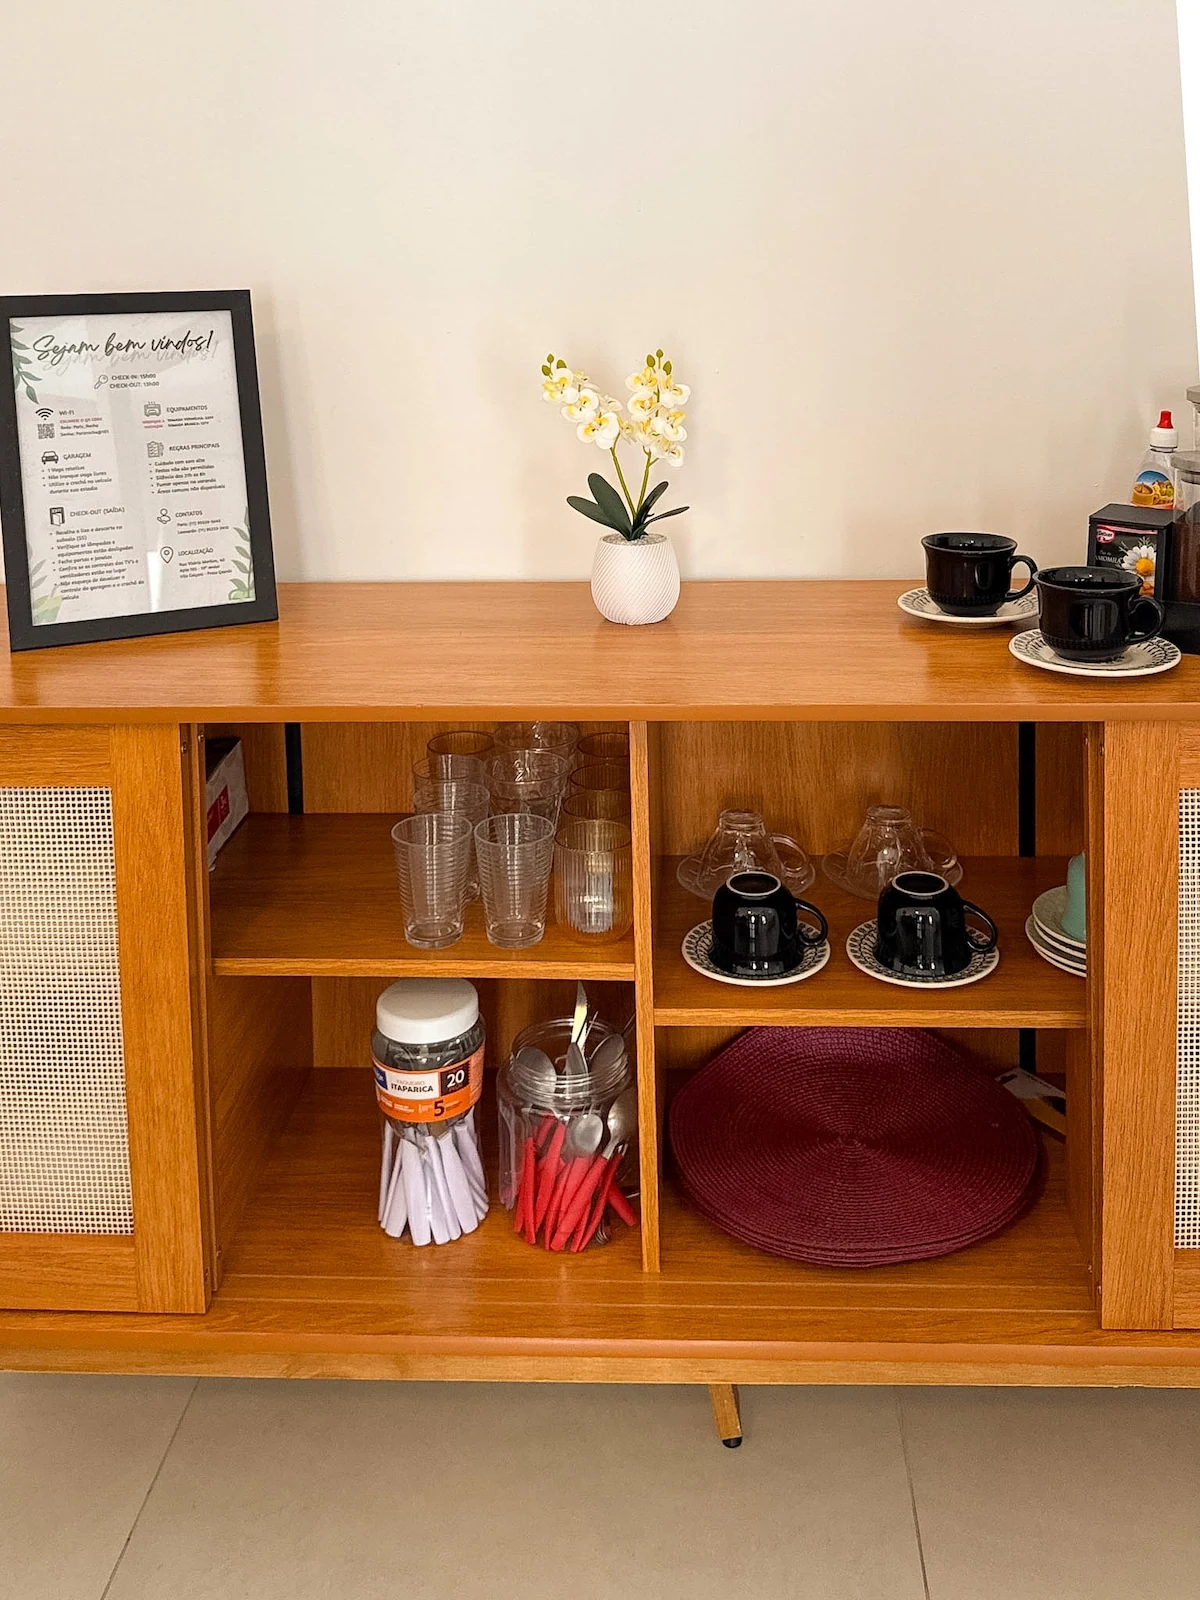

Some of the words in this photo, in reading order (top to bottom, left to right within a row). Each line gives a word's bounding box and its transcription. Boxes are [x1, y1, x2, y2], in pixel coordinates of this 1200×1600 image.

[33, 334, 100, 366] Sejam
[104, 332, 145, 357] bem
[151, 330, 214, 353] vindos!
[166, 405, 208, 413] EQUIPAMENTOS
[191, 442, 220, 450] PRINCIPAIS
[70, 509, 102, 517] CHECK-OUT
[103, 506, 125, 514] (SAÍDA)
[178, 548, 214, 556] LOCALIZAÇÃO
[447, 1070, 465, 1088] 20
[391, 1083, 434, 1093] ITAPARICA
[434, 1100, 445, 1117] 5
